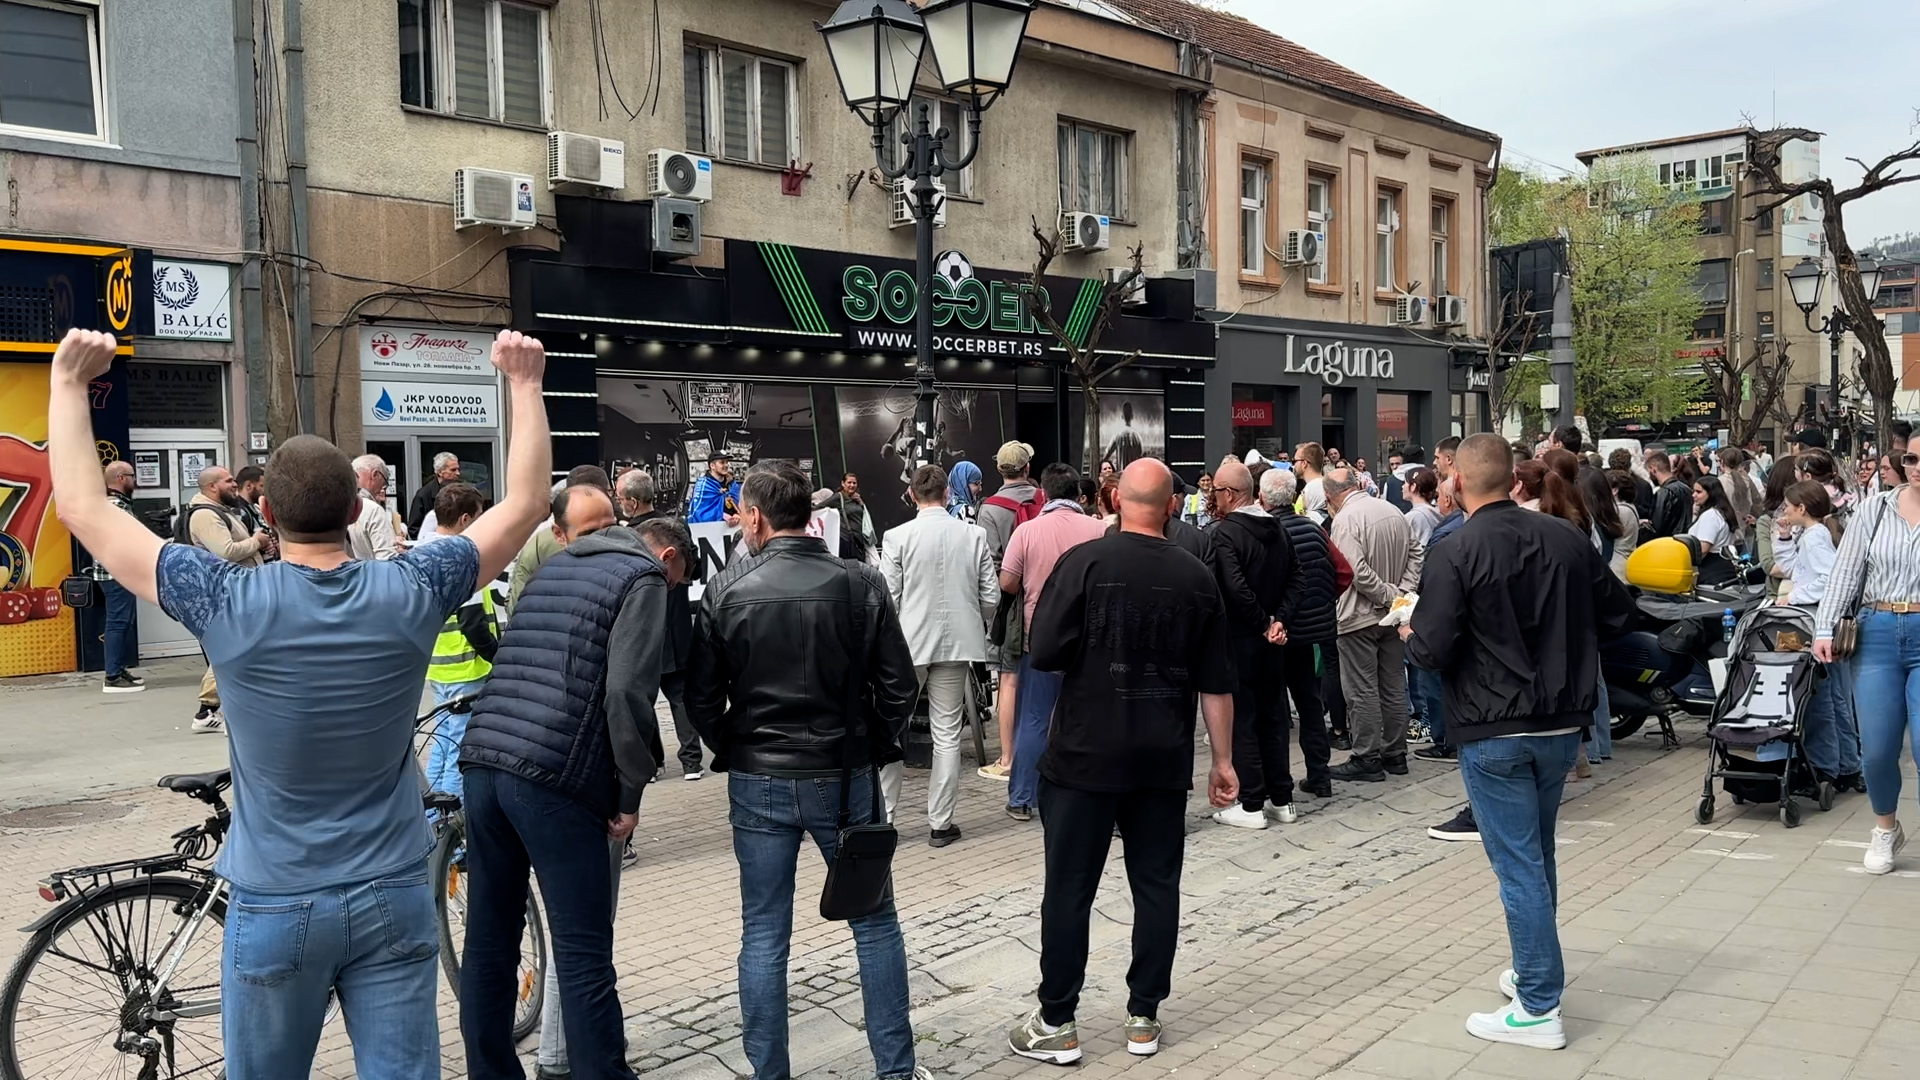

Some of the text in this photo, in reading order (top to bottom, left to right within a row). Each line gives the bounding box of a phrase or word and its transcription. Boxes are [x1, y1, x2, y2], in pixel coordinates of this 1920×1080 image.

[603, 146, 622, 155] BEKO
[165, 281, 186, 293] MS
[162, 313, 228, 329] BALIĆ
[857, 330, 1043, 356] WWW.OCCERBET.RS
[1284, 334, 1394, 386] Laguna
[403, 394, 483, 405] JKP VODOVOD
[399, 405, 487, 416] I KANALIZACIJA
[1232, 406, 1265, 422] Laguna
